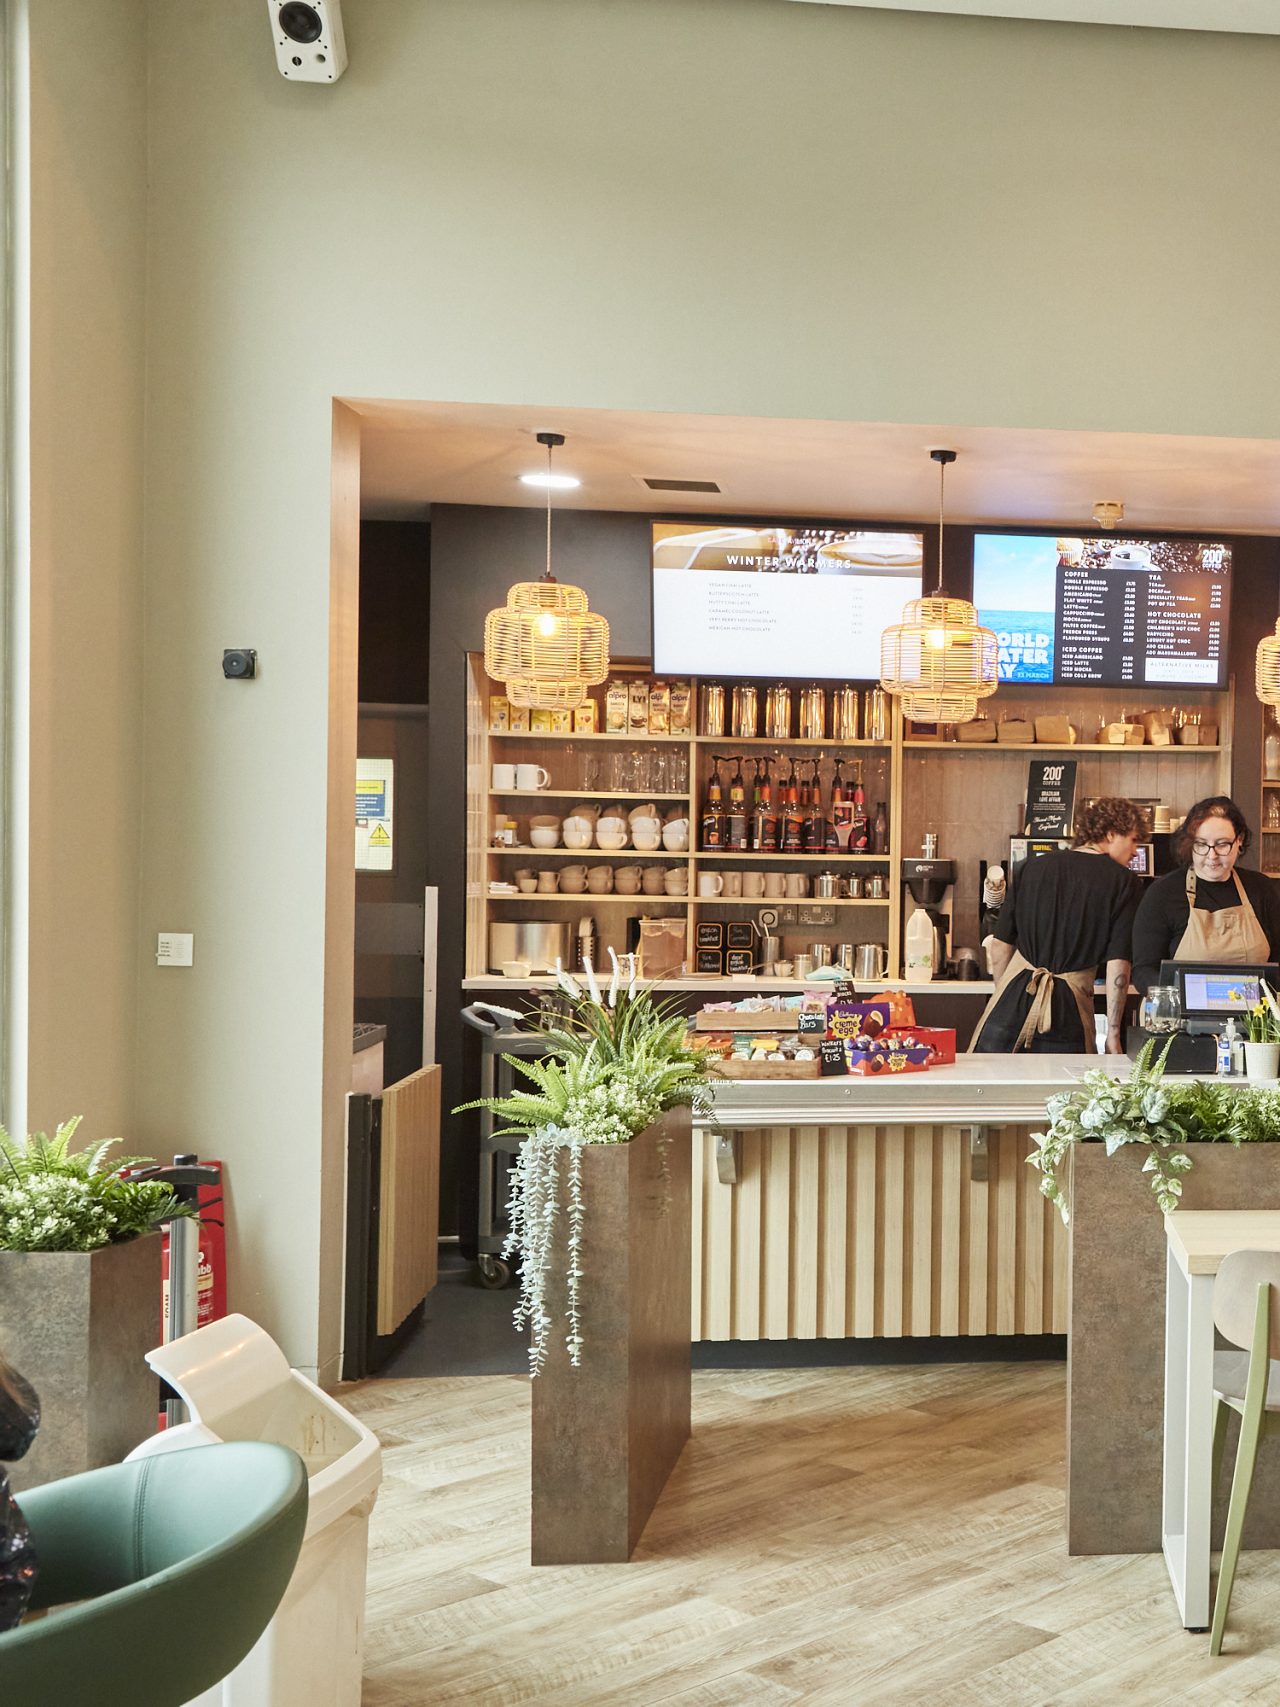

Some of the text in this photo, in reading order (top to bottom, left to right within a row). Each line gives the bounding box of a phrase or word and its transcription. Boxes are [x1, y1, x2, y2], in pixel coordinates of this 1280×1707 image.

[727, 554, 852, 569] WINTER WARMERS
[998, 632, 1050, 648] ORLD
[998, 648, 1048, 664] ATER
[998, 664, 1018, 678] AY
[608, 692, 626, 700] alpro
[800, 1020, 816, 1029] Bars
[834, 1020, 857, 1030] creme
[838, 1026, 854, 1036] egg
